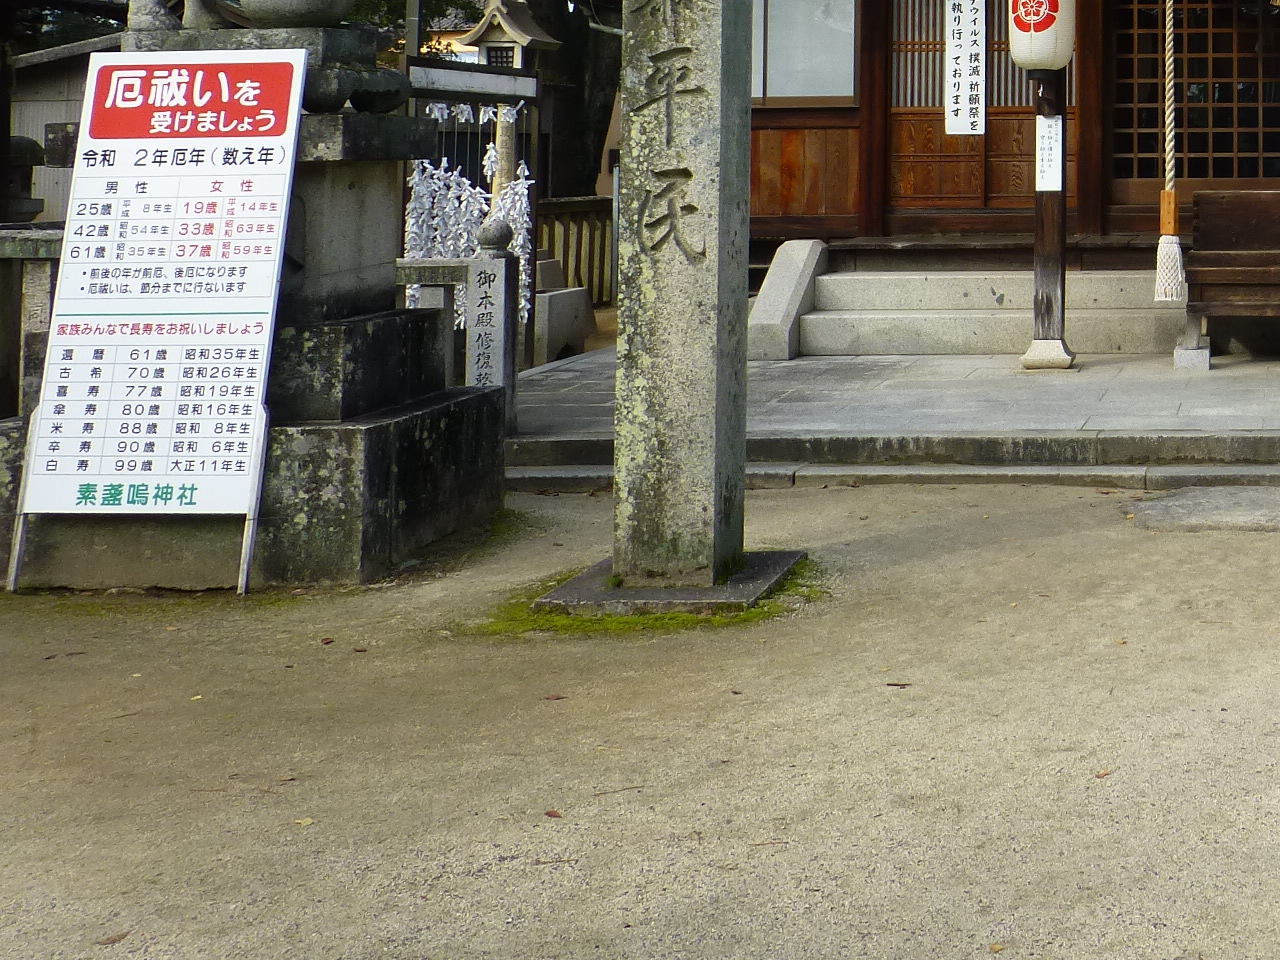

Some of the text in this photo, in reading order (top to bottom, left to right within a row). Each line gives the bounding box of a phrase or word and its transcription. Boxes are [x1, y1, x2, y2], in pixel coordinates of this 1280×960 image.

[104, 69, 261, 108] 厄祓いを
[149, 109, 276, 134] 受けましょう
[82, 149, 116, 168] 令和
[76, 202, 113, 217] 25歳
[183, 201, 218, 215] 19歳
[73, 224, 110, 238] 42歳
[178, 222, 215, 237] 33歳
[70, 246, 106, 260] 61歳
[175, 244, 212, 258] 37歳
[56, 321, 265, 337] 家族みんなで長寿をお祝いしましょう
[129, 347, 168, 361] 61歳
[184, 346, 260, 361] 昭和35年生
[127, 366, 166, 380] 70歳
[182, 365, 258, 380] 昭和26年生
[125, 384, 163, 398] 77歳
[179, 383, 256, 398] 昭和19年生
[122, 403, 161, 416] 80歳
[177, 402, 253, 416] 昭和16年生
[119, 422, 158, 435] 88歳
[117, 440, 156, 453] 90歳
[114, 459, 153, 472] 99歳
[170, 458, 247, 472] 大正11年生
